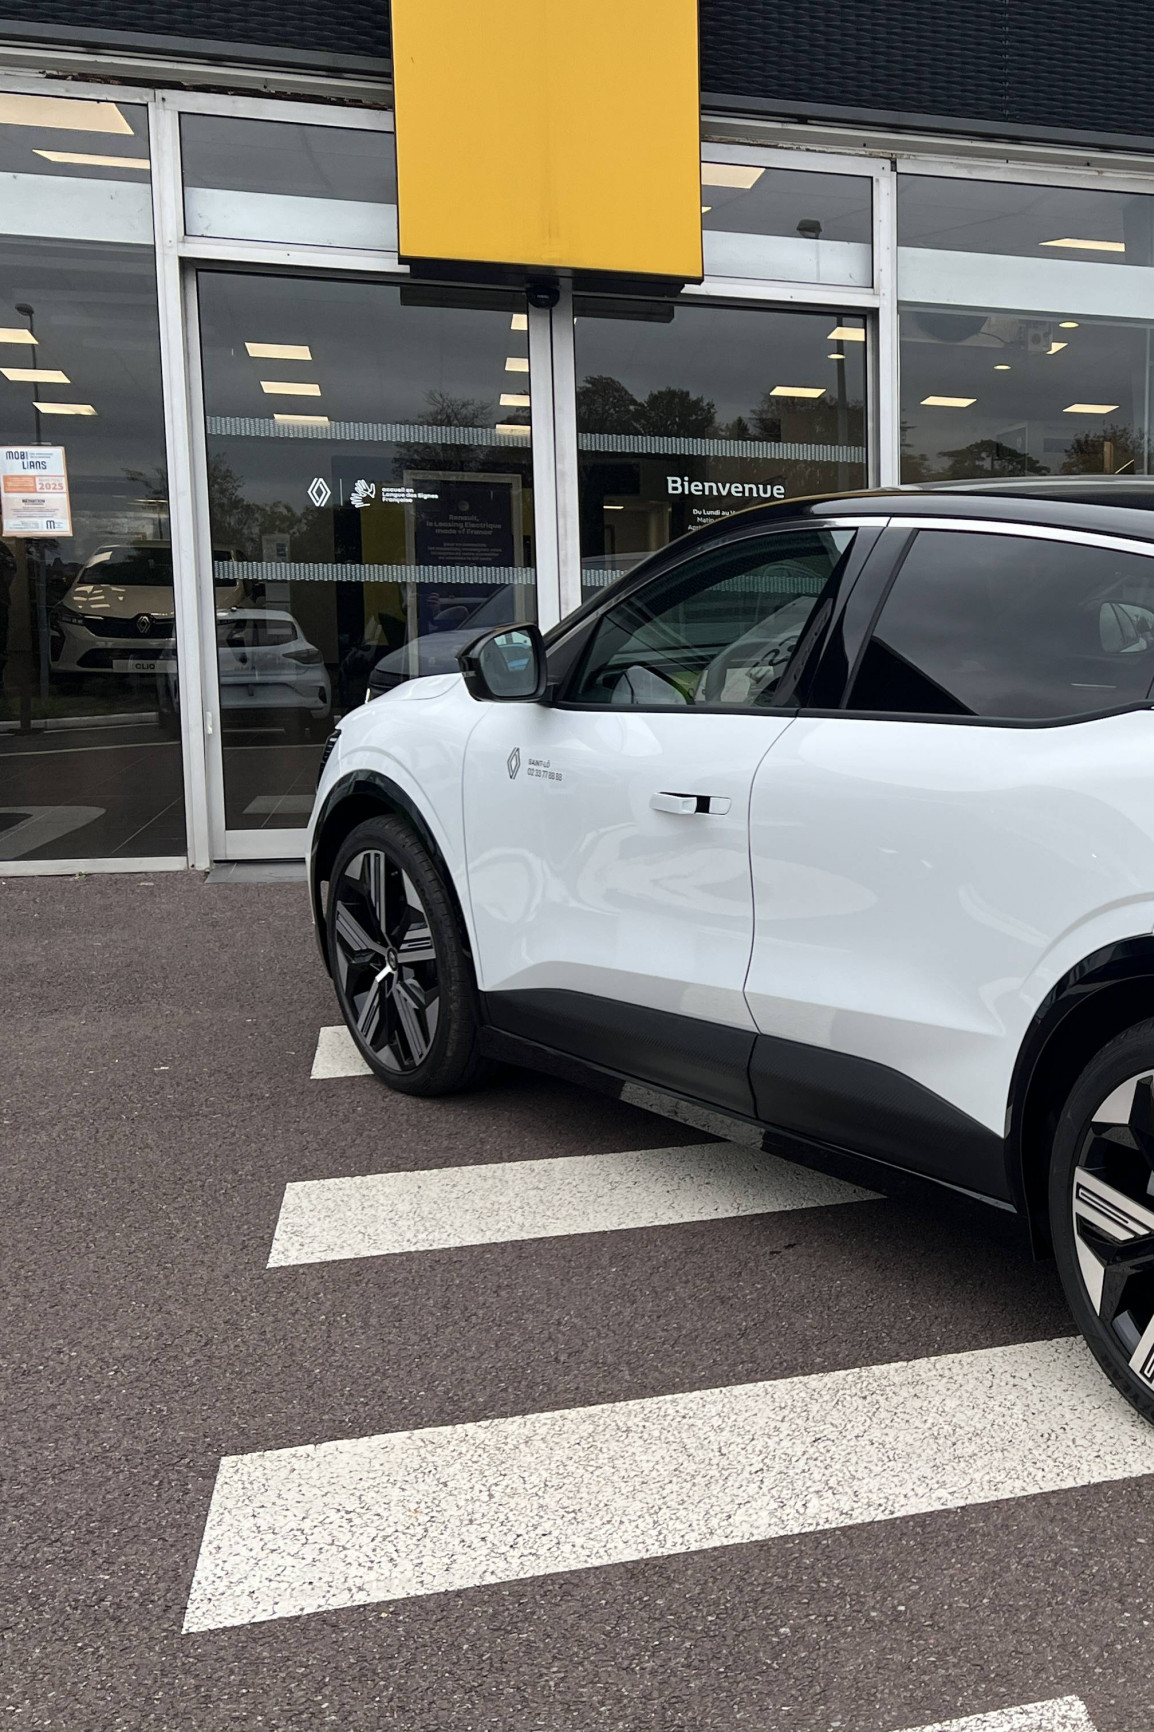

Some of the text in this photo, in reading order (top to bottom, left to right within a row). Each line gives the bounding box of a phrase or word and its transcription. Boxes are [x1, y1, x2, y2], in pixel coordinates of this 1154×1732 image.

[38, 482, 64, 490] 2025
[666, 476, 785, 498] Bienvenue
[702, 508, 720, 516] Lundi
